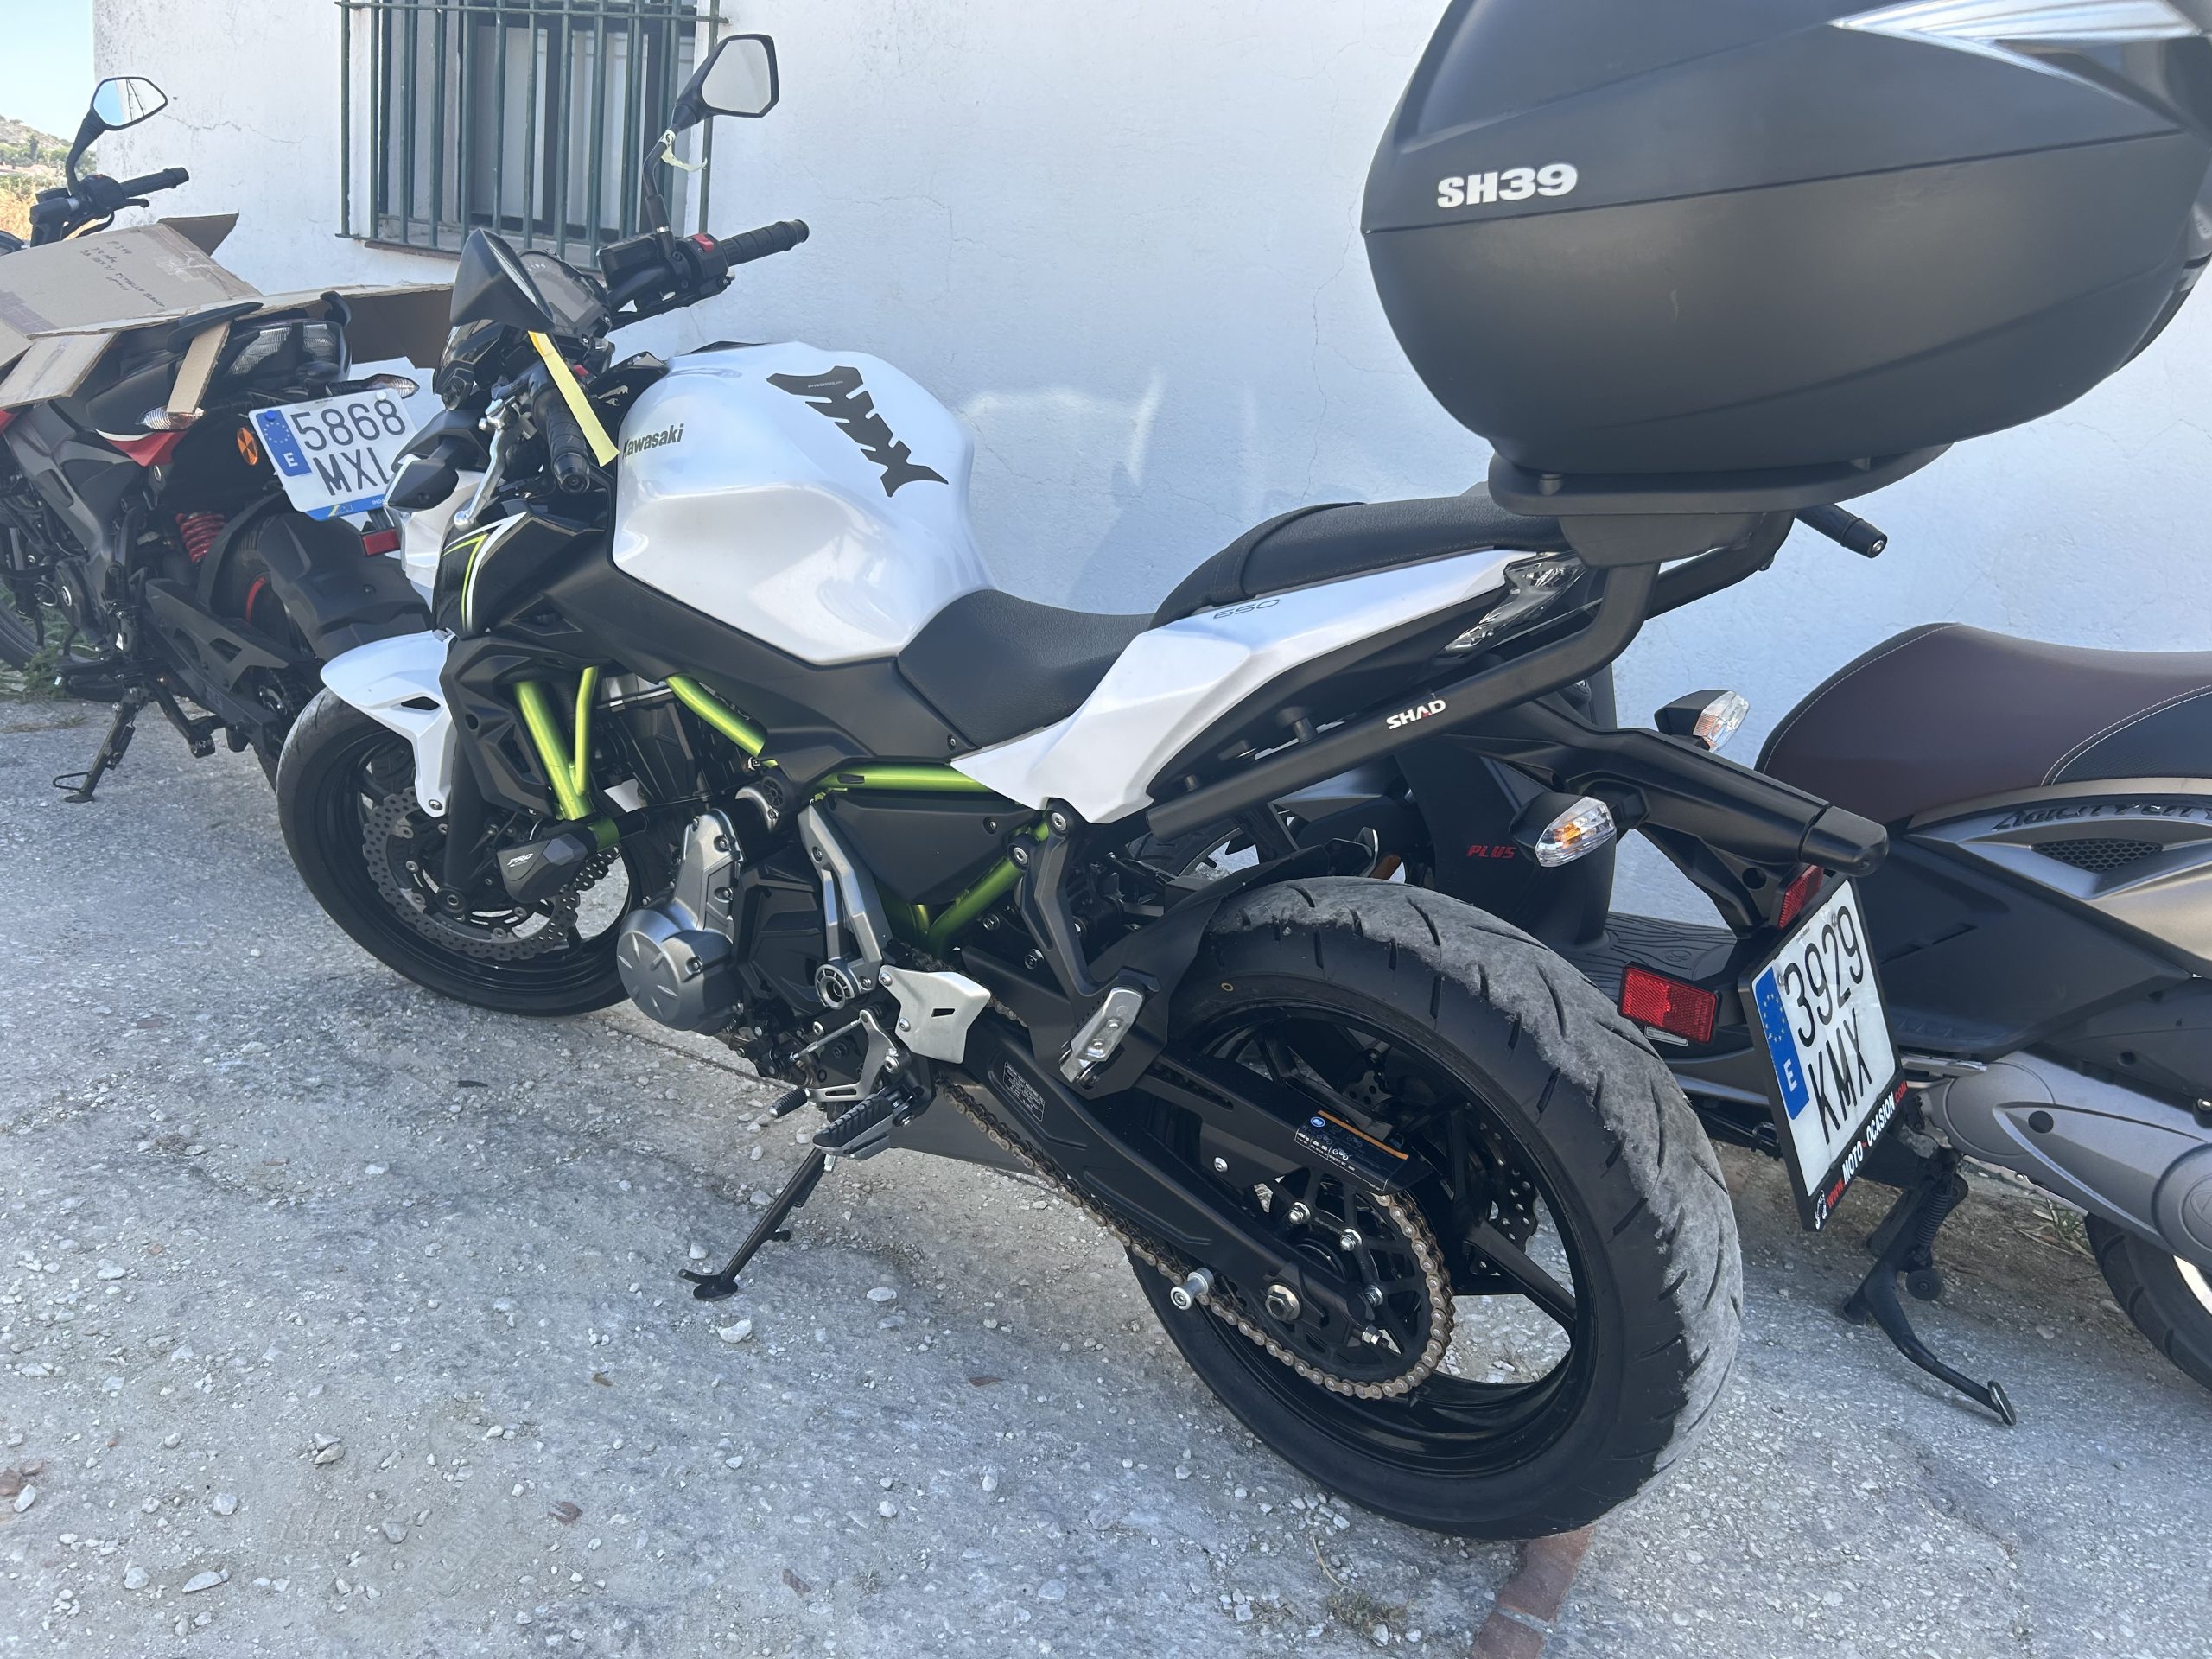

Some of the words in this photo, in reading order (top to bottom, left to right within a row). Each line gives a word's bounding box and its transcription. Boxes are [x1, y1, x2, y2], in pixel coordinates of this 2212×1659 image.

[1437, 163, 1578, 208] SH39
[290, 399, 406, 451] 5868
[622, 423, 684, 460] Kawasaki
[283, 453, 298, 467] E
[1213, 599, 1281, 620] 650
[1386, 699, 1446, 730] SHAD
[1466, 845, 1516, 858] PLUS
[1783, 906, 1864, 1048] 3929
[1783, 1058, 1797, 1092] E
[1808, 1007, 1872, 1145] KMX
